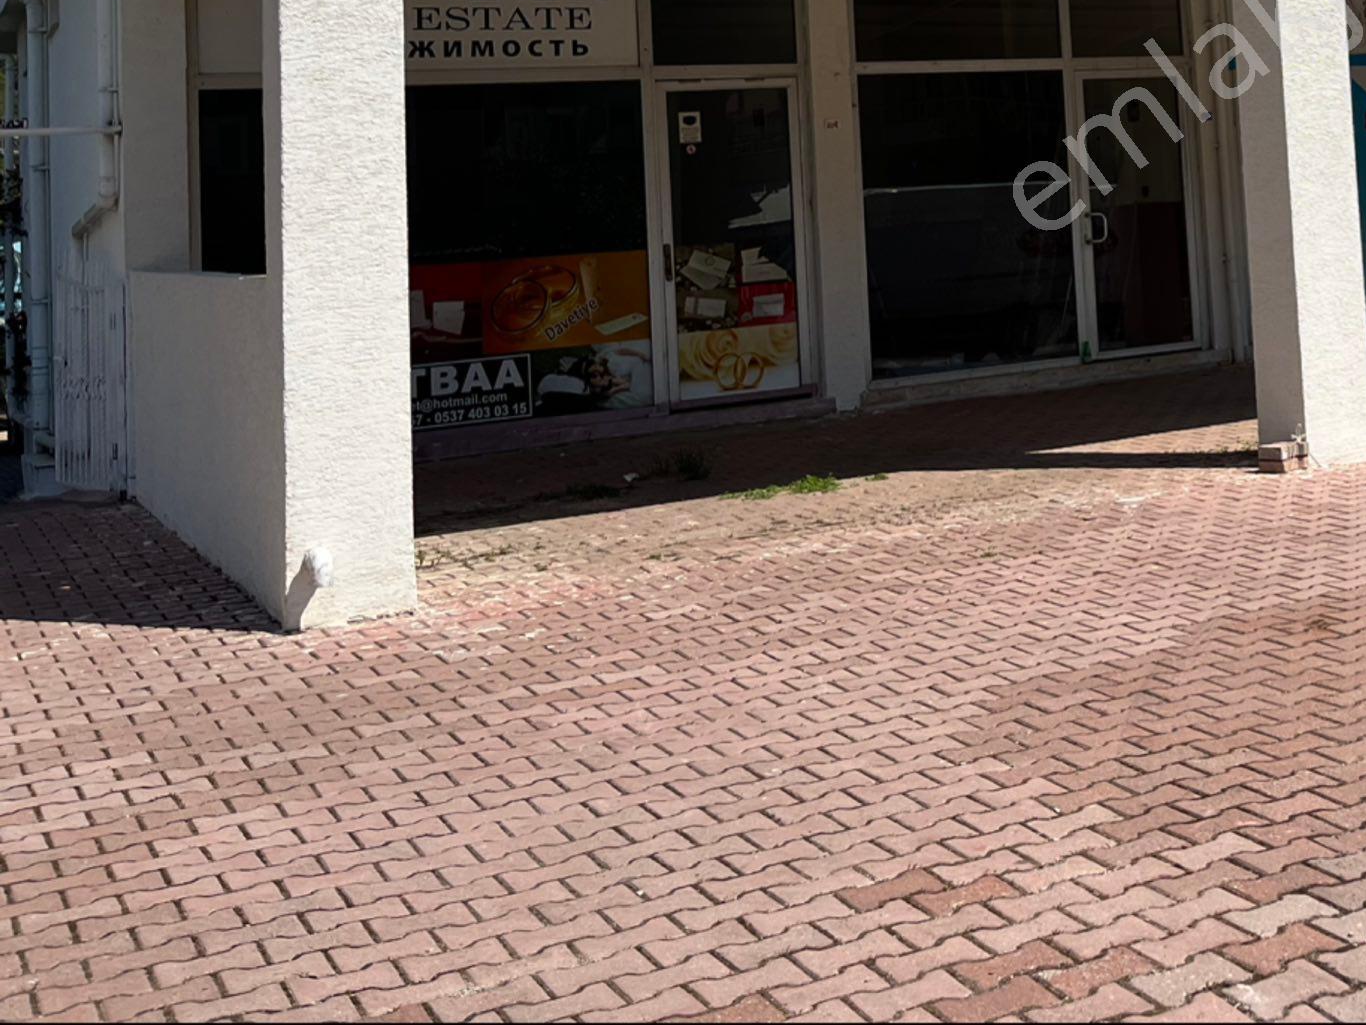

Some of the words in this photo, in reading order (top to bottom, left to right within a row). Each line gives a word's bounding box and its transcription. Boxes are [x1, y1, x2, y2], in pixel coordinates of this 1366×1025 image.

[412, 6, 592, 31] ESTATE
[544, 296, 600, 342] Davetiye
[434, 408, 465, 424] 0537
[466, 406, 491, 419] 403
[494, 403, 510, 417] 03
[512, 401, 527, 415] 15
